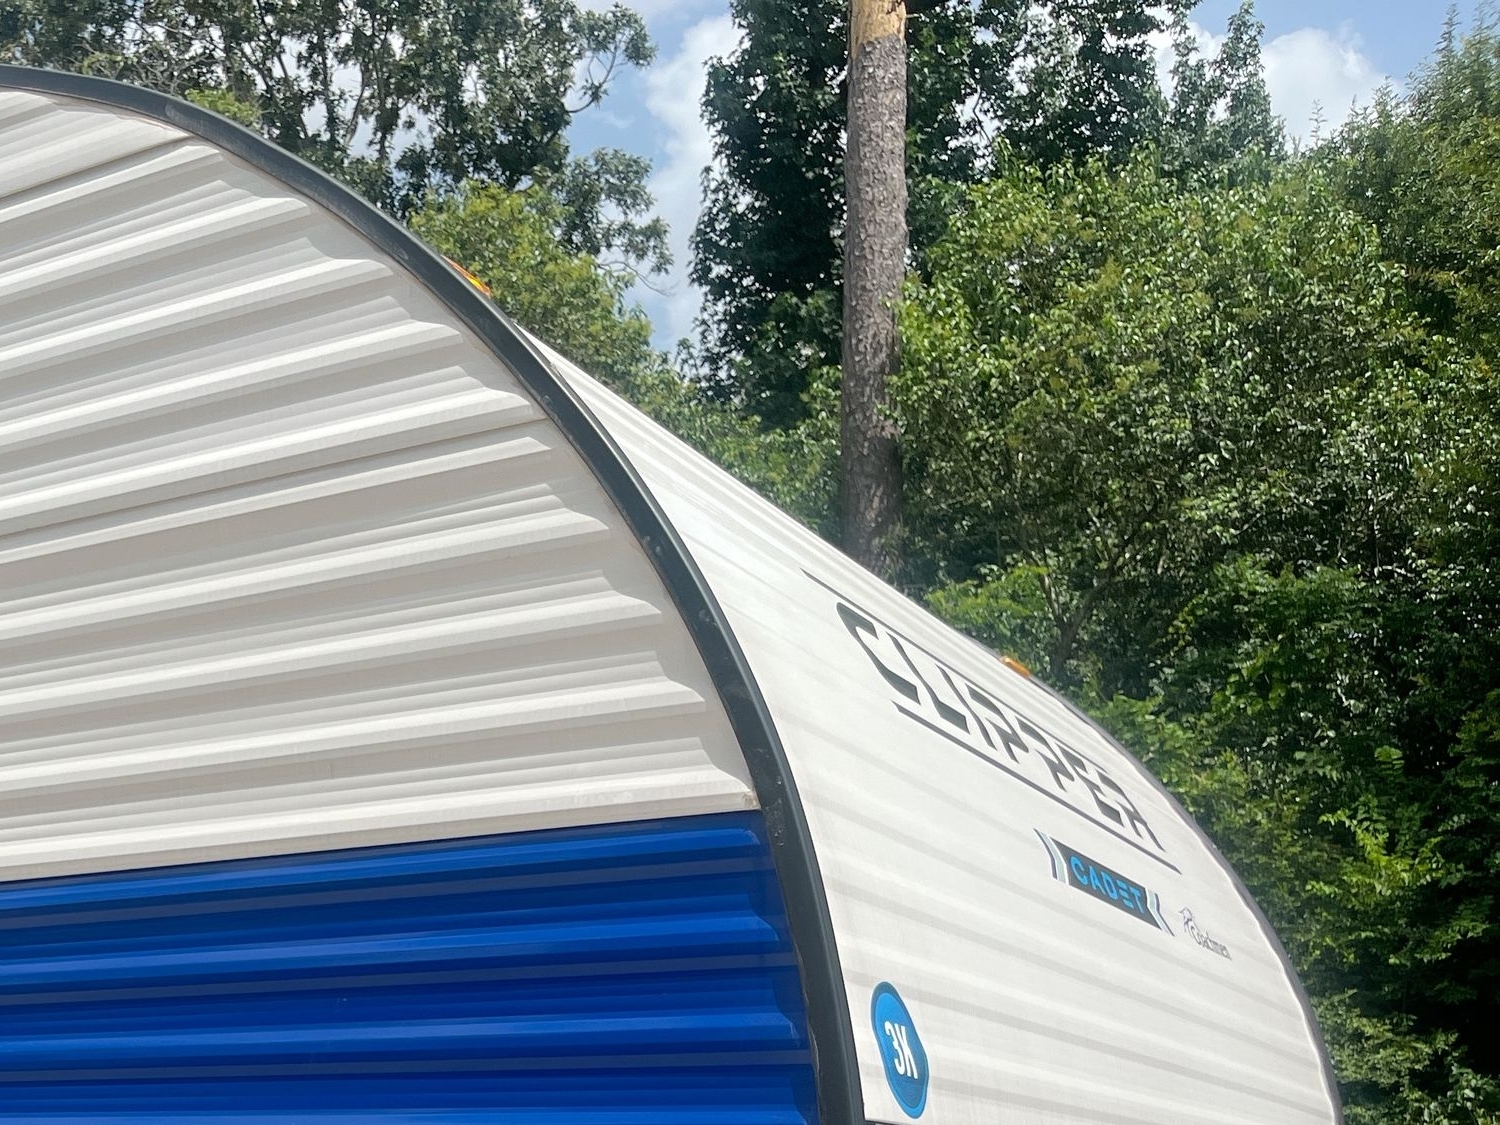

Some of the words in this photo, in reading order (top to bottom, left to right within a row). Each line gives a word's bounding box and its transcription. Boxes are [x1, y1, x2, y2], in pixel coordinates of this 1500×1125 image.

[836, 602, 1166, 852] CLIPPER
[1070, 855, 1145, 914] CADET
[884, 1020, 918, 1079] 3K
